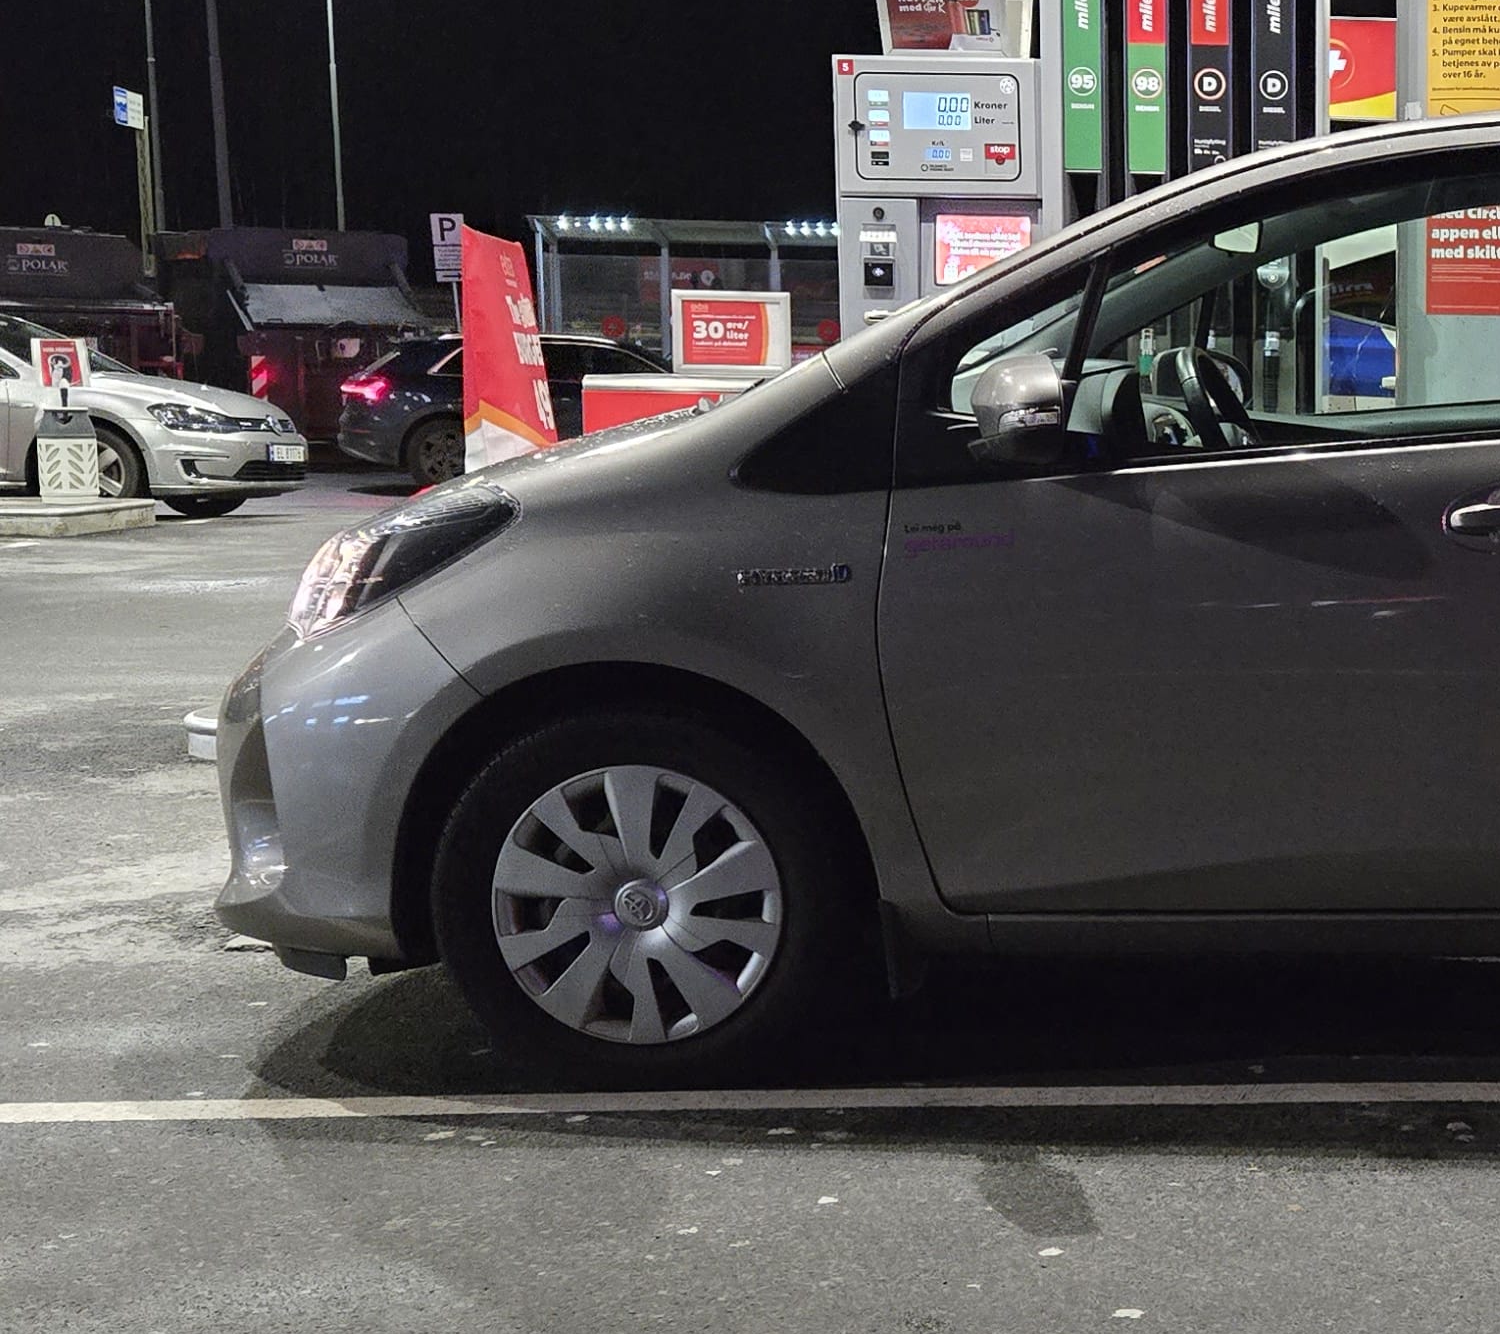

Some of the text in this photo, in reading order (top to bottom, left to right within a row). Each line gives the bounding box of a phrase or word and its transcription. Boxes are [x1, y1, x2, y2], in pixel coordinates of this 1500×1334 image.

[899, 3, 922, 12] med
[1442, 4, 1497, 14] Kupevarmer
[1466, 13, 1500, 23] avslått.
[1442, 26, 1472, 35] Bensin
[1473, 25, 1486, 34] må
[1442, 36, 1453, 46] på
[1454, 38, 1480, 47] egnet
[1442, 49, 1476, 58] Pumper
[1478, 48, 1496, 57] skal
[1442, 59, 1479, 69] betjenes
[1070, 74, 1096, 89] 95
[1135, 76, 1160, 91] 98
[1202, 77, 1217, 91] D
[1267, 78, 1281, 92] D
[974, 101, 1008, 110] Kroner
[974, 116, 996, 125] Liter
[990, 145, 1010, 155] stop
[439, 217, 456, 242] P
[1431, 228, 1480, 242] appen
[1431, 245, 1465, 259] med
[692, 320, 724, 340] 30
[726, 330, 749, 340] liter
